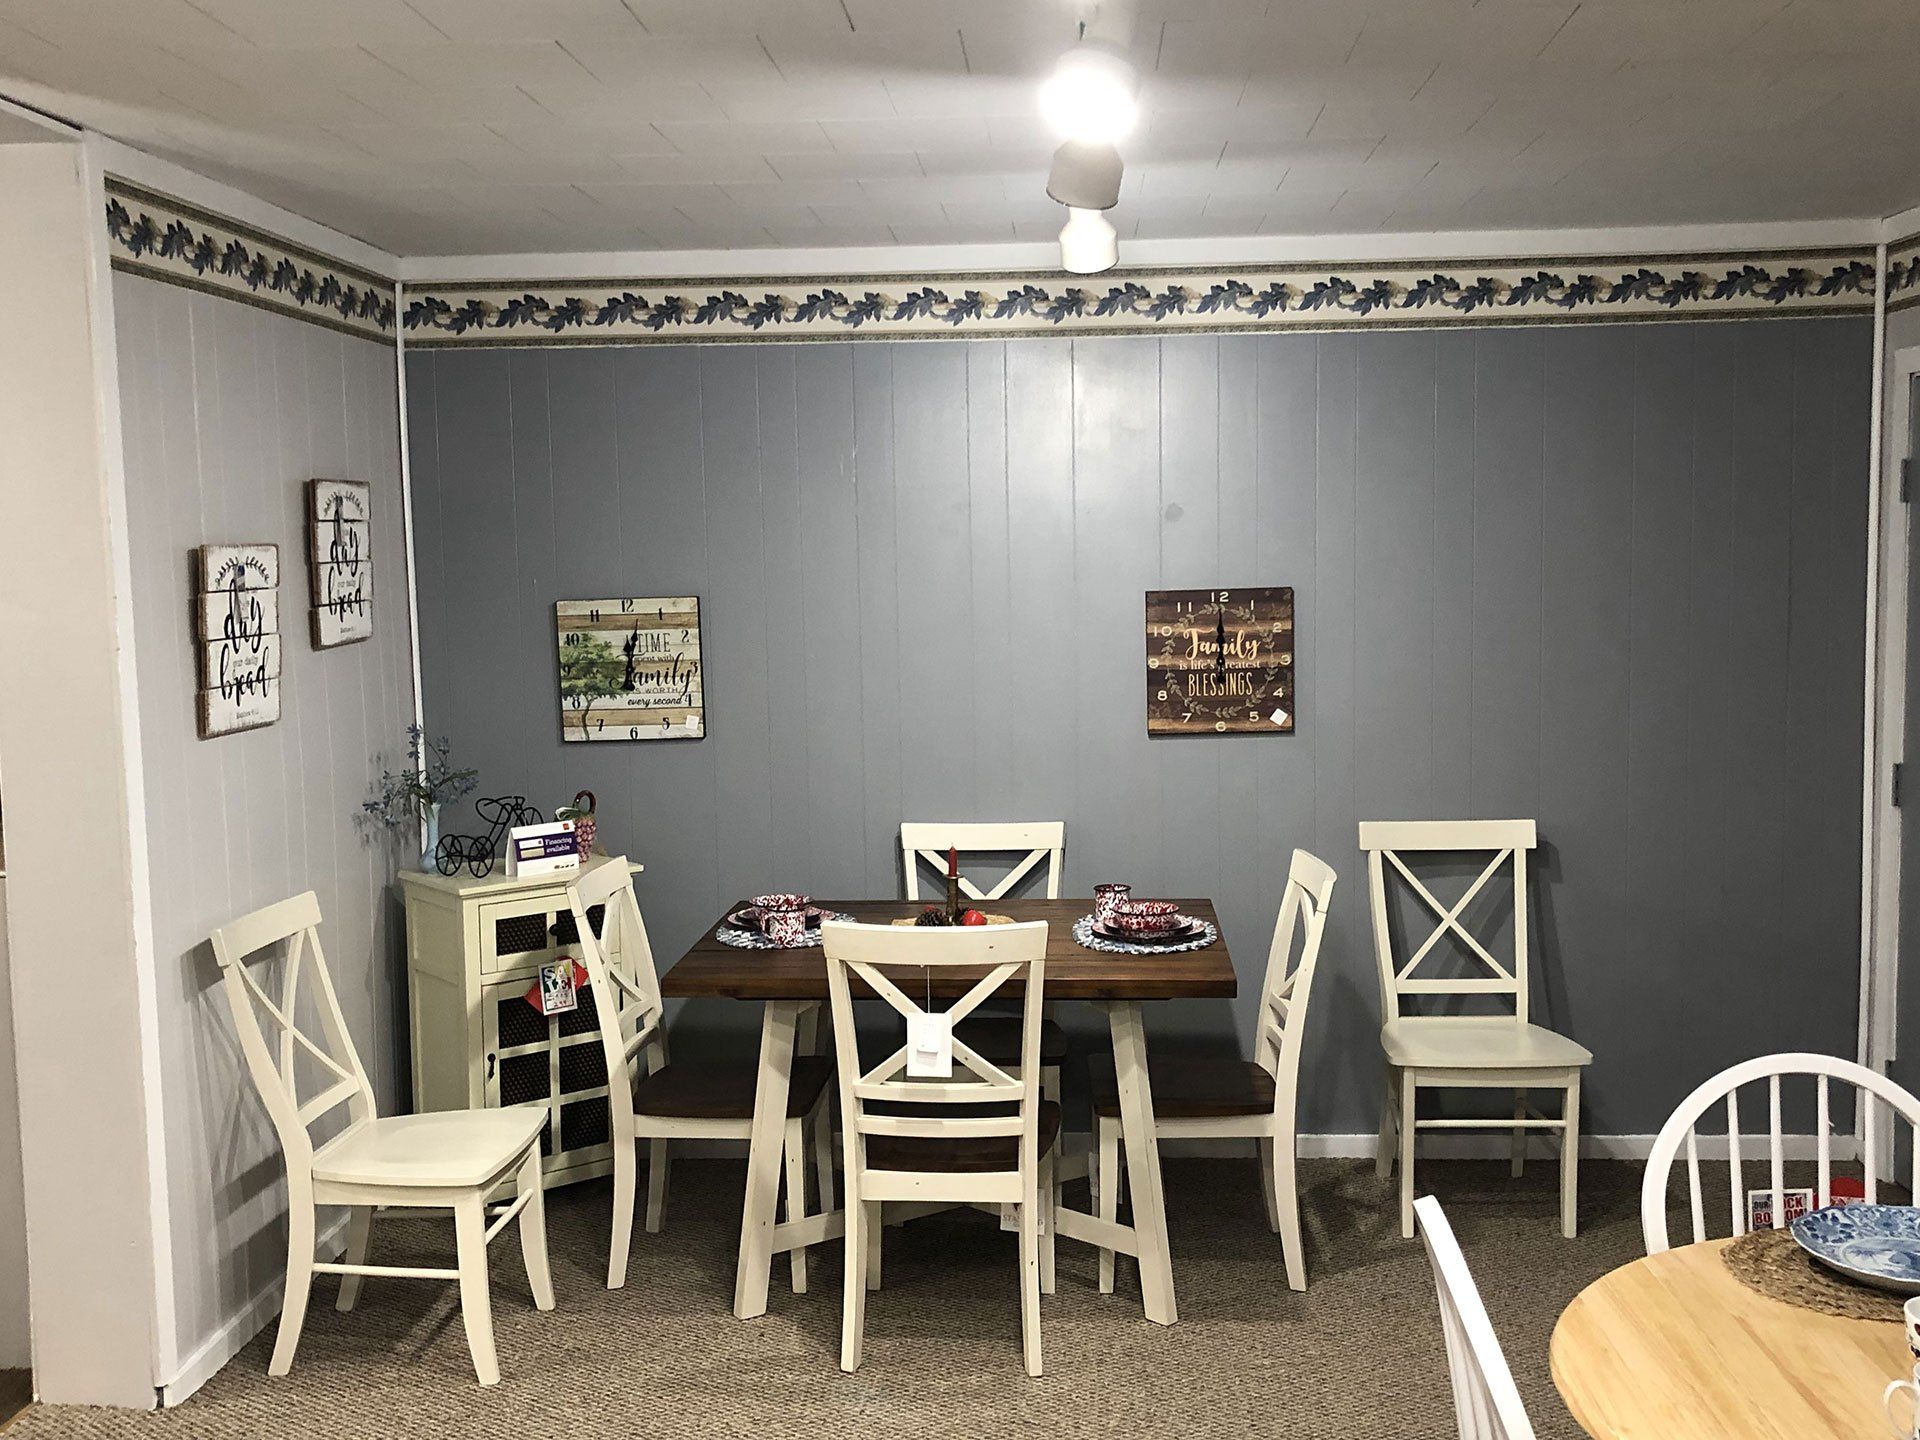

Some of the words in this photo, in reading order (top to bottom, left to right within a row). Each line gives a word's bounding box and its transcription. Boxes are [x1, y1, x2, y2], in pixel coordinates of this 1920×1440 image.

[328, 565, 364, 623] bread
[1211, 591, 1230, 602] 12
[621, 599, 634, 612] 12
[1177, 601, 1192, 613] 11
[1250, 599, 1255, 611] 1
[224, 578, 264, 655] day
[590, 609, 600, 622] 11
[658, 607, 664, 621] 1
[1154, 625, 1173, 637] 10
[1272, 622, 1282, 633] 2
[565, 633, 580, 646] 10
[681, 629, 690, 643] 2
[637, 632, 671, 653] TIME
[1183, 628, 1262, 661] Family
[658, 653, 675, 662] with
[1148, 657, 1160, 669] 9
[1279, 654, 1291, 666] 3
[689, 661, 698, 675] 3
[1179, 661, 1188, 671] is
[1190, 659, 1215, 671] life's
[219, 642, 270, 706] bread
[1157, 690, 1168, 701] 8
[1272, 687, 1284, 698] 4
[571, 696, 581, 709] 8
[627, 697, 651, 708] every
[652, 695, 683, 706] second
[1182, 712, 1193, 723] 7
[1249, 711, 1259, 722] 5
[596, 718, 604, 732] 7
[661, 717, 670, 730] 5
[1215, 721, 1227, 732] 6
[629, 727, 638, 740] 6
[545, 836, 573, 847] Financing
[546, 844, 571, 854] available
[1753, 1201, 1769, 1209] OUR
[1755, 1208, 1807, 1224] BOOM!
